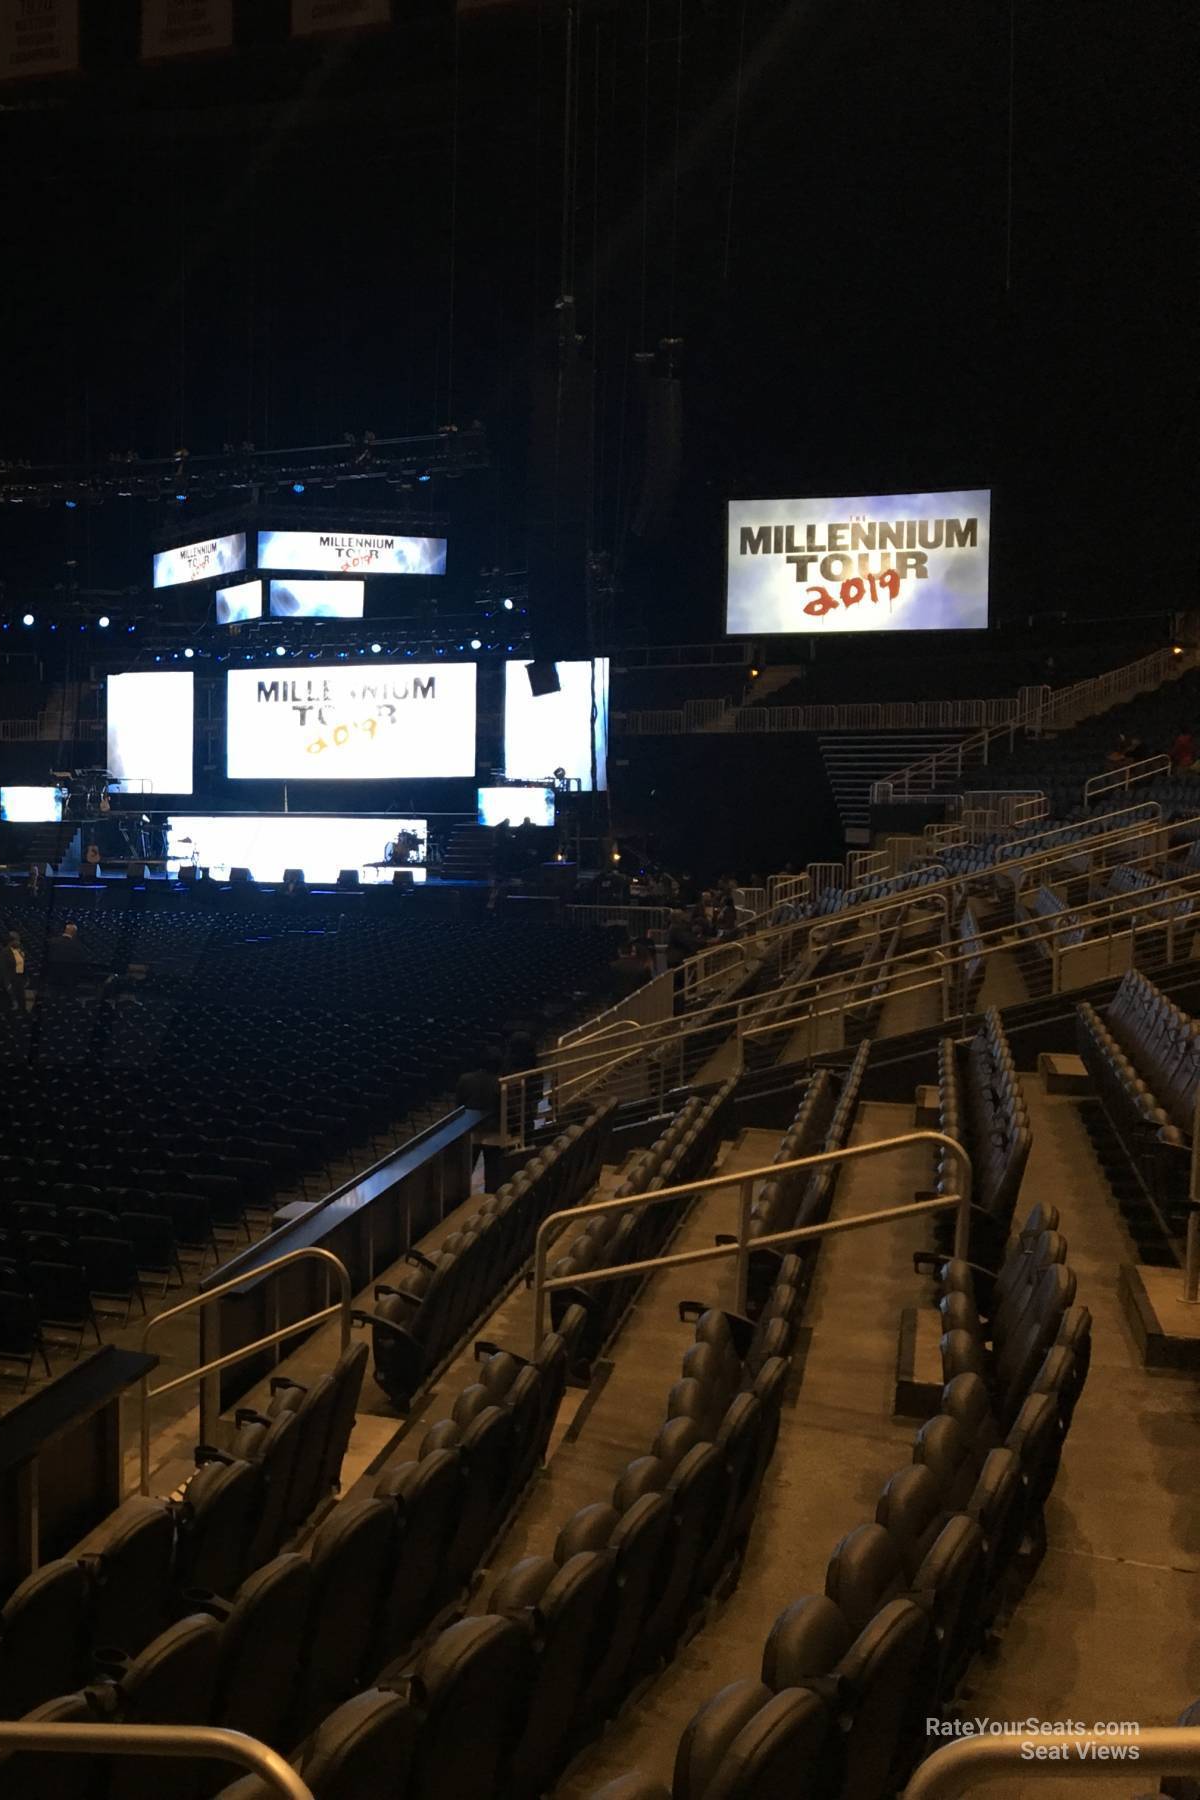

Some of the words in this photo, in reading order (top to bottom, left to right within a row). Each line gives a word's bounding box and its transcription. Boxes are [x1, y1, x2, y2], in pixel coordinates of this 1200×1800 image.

[320, 536, 394, 550] MILLENNIUM
[740, 518, 978, 555] MILLENNIUM
[786, 551, 928, 583] TOUR
[803, 569, 901, 616] 2019
